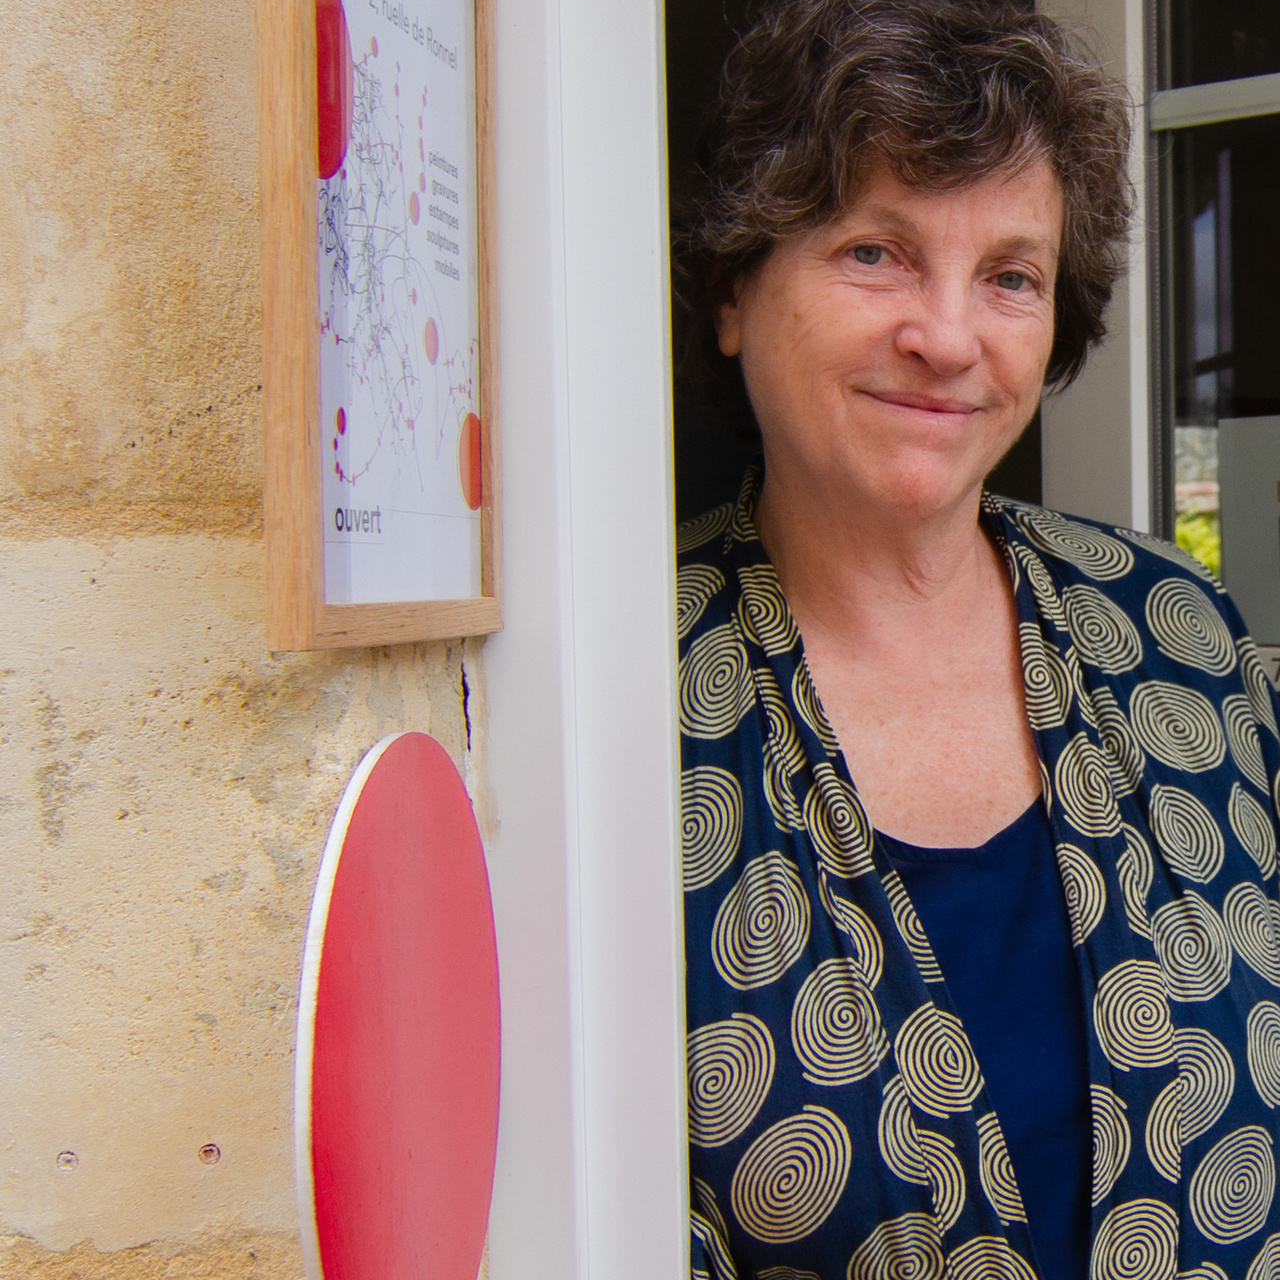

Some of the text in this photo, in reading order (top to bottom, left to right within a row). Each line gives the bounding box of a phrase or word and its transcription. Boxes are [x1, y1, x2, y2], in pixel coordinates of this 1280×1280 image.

[412, 16, 425, 47] de
[428, 150, 459, 180] peintures
[432, 179, 459, 205] gravures
[426, 229, 460, 256] sculptures
[433, 259, 460, 282] mobiles
[334, 505, 382, 535] ouvert
